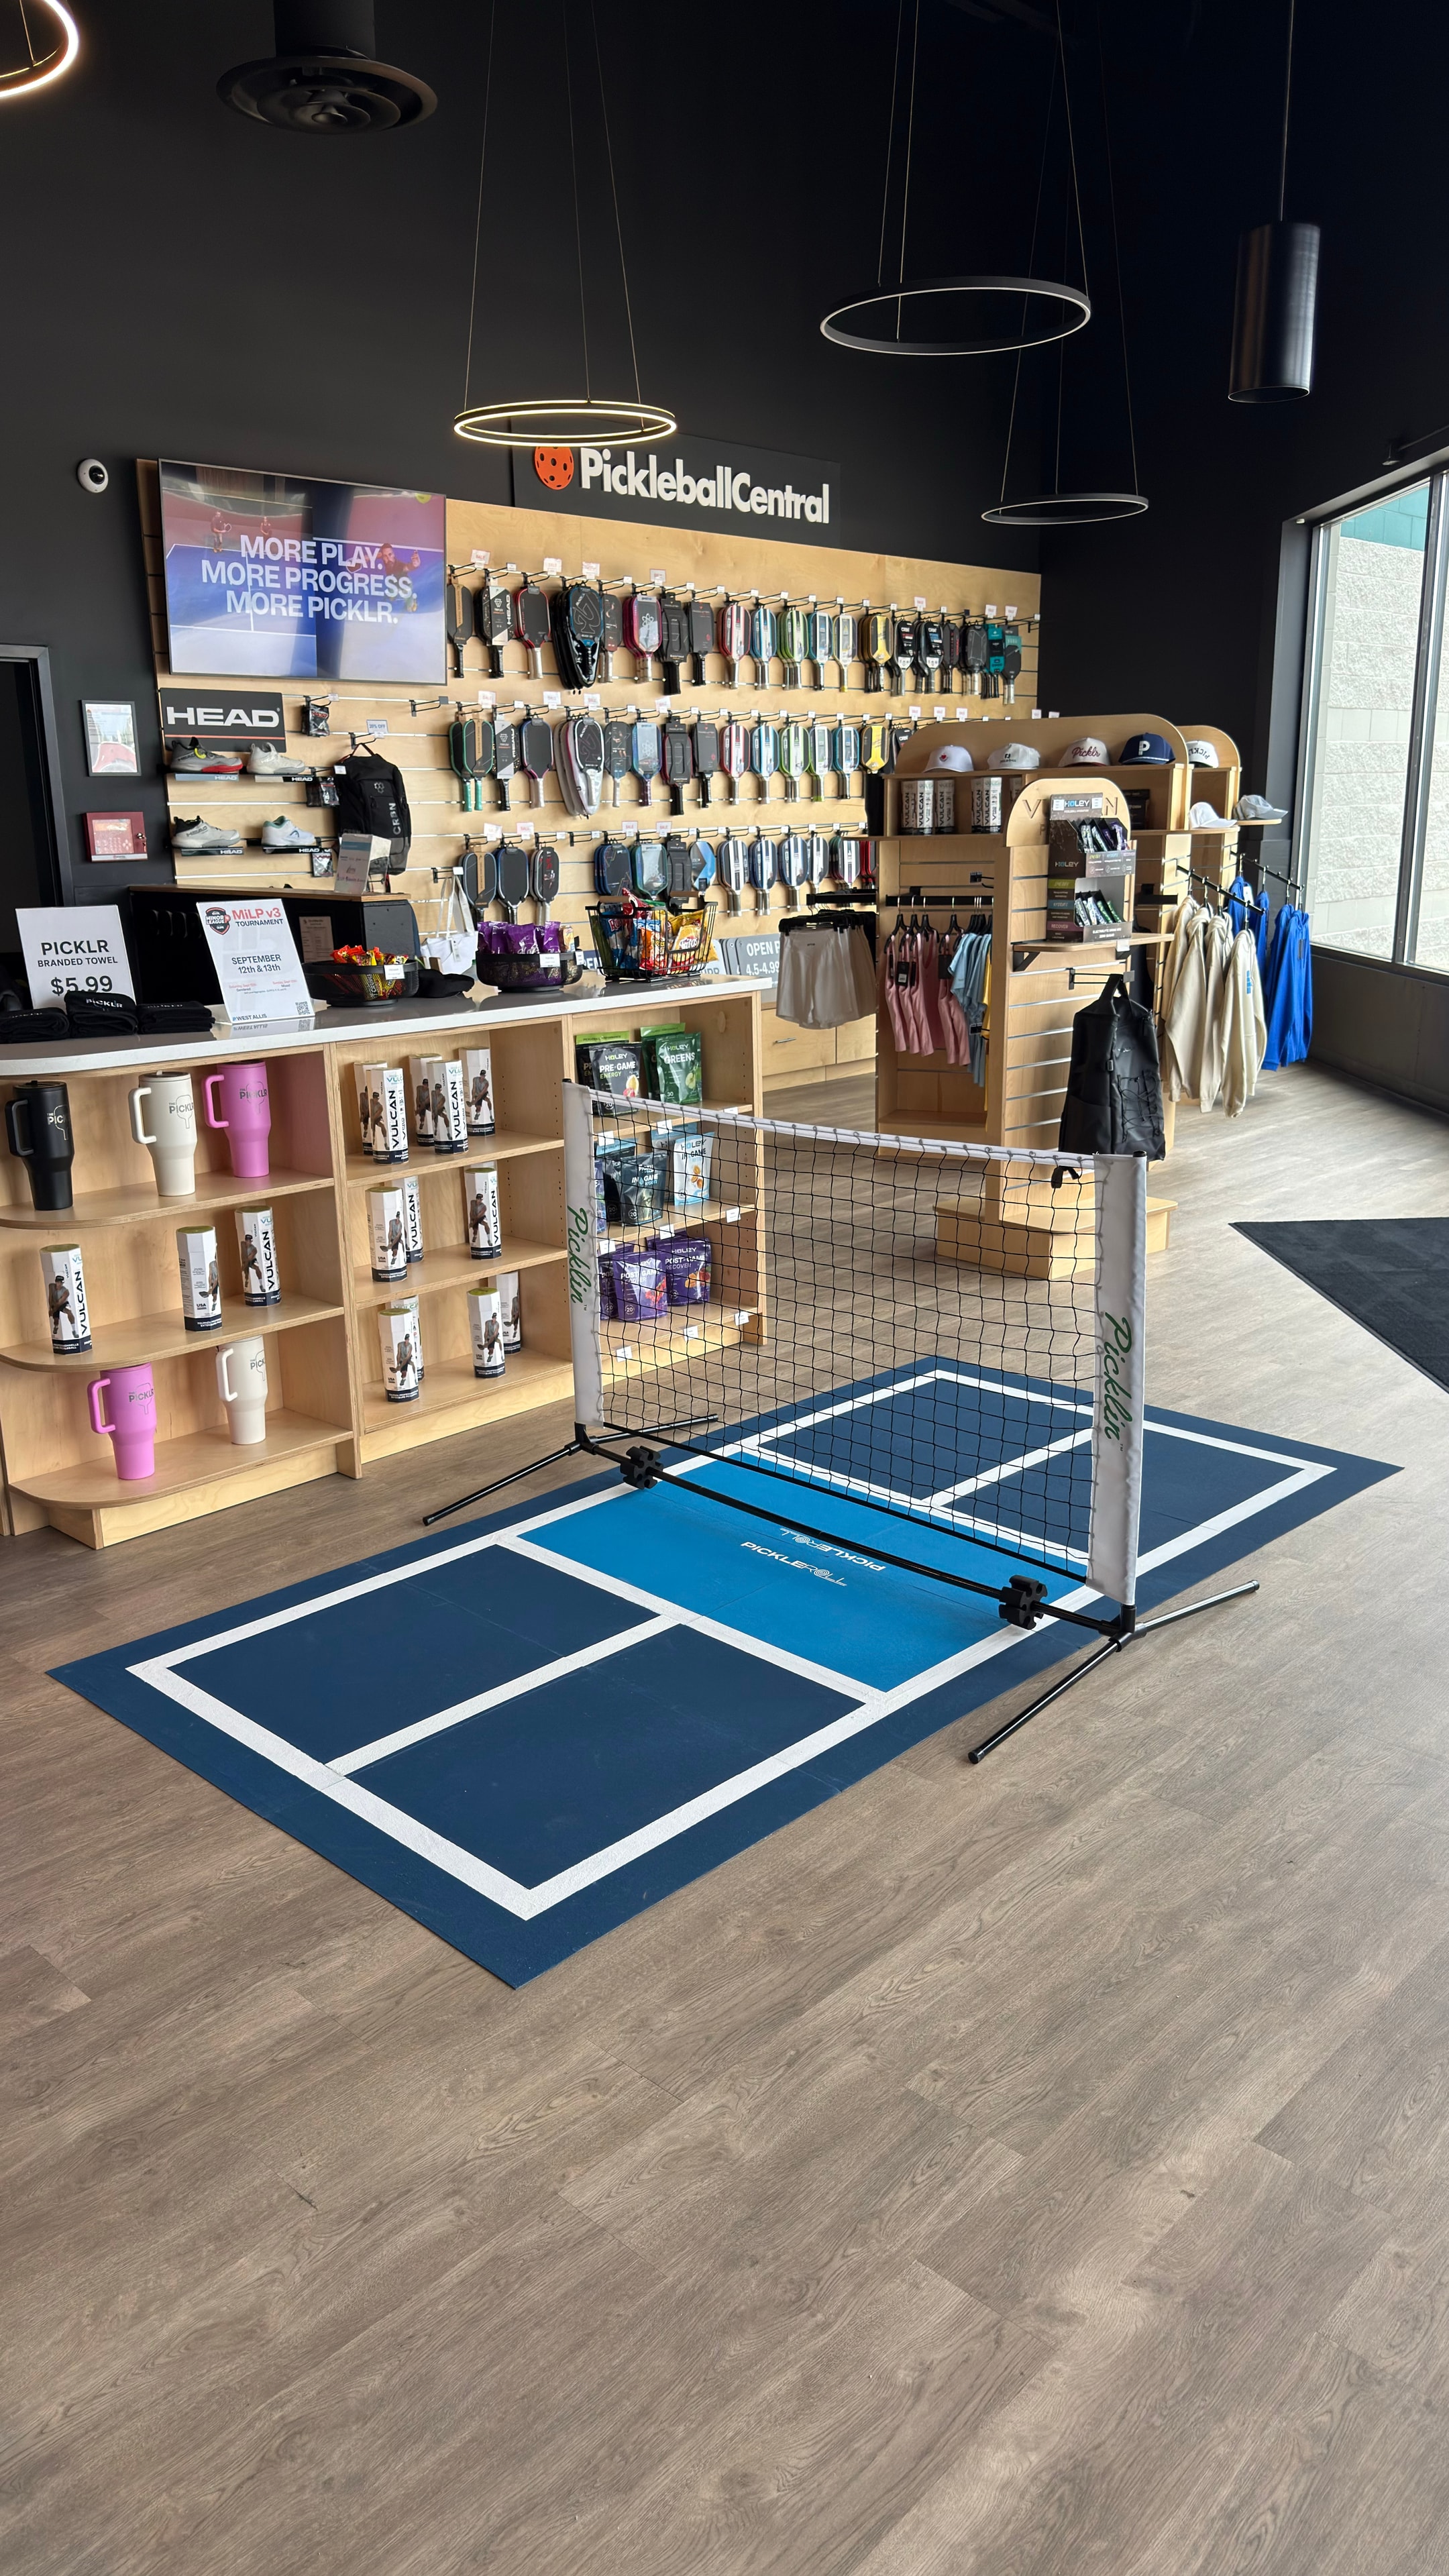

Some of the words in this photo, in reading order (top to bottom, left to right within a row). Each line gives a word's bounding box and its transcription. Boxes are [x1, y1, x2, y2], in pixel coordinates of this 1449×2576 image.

[580, 447, 829, 523] PickleballCentral
[240, 535, 317, 564] MORE
[321, 542, 383, 570] PLAY.
[201, 559, 280, 588] MORE
[285, 566, 417, 599] PROGRESS.
[226, 590, 303, 618] MORE
[308, 597, 398, 624] PICKLR.
[166, 706, 280, 728] HEAD
[1071, 746, 1101, 758] Picklr
[388, 802, 402, 835] CRBN
[1064, 800, 1090, 808] HOLEY
[231, 908, 264, 920] MiLP
[266, 907, 282, 918] v3
[235, 918, 284, 927] TOURNAMENT
[38, 958, 83, 967] BRANDED
[86, 956, 118, 965] TOWEL
[41, 939, 110, 956] PICKLR
[231, 954, 282, 965] SEPTEMBER
[747, 941, 774, 957] OPEN
[51, 975, 113, 996] $5.99
[238, 966, 256, 974] 12th
[605, 1053, 628, 1061] HOLEY
[664, 1053, 695, 1065] GREENS
[600, 1071, 622, 1079] ENERGY
[388, 1090, 400, 1150] VULCAN
[450, 1081, 462, 1139] VULCAN
[408, 1194, 419, 1249] VULCAN
[490, 1190, 498, 1244] VULCAN
[262, 1230, 276, 1290] VULCAN
[568, 1205, 592, 1303] Picklin
[74, 1271, 87, 1336] VULCAN
[1104, 1312, 1132, 1441] Picklin
[741, 1542, 847, 1587] PICKLEROLL
[780, 1527, 886, 1572] PICKLEROLL
